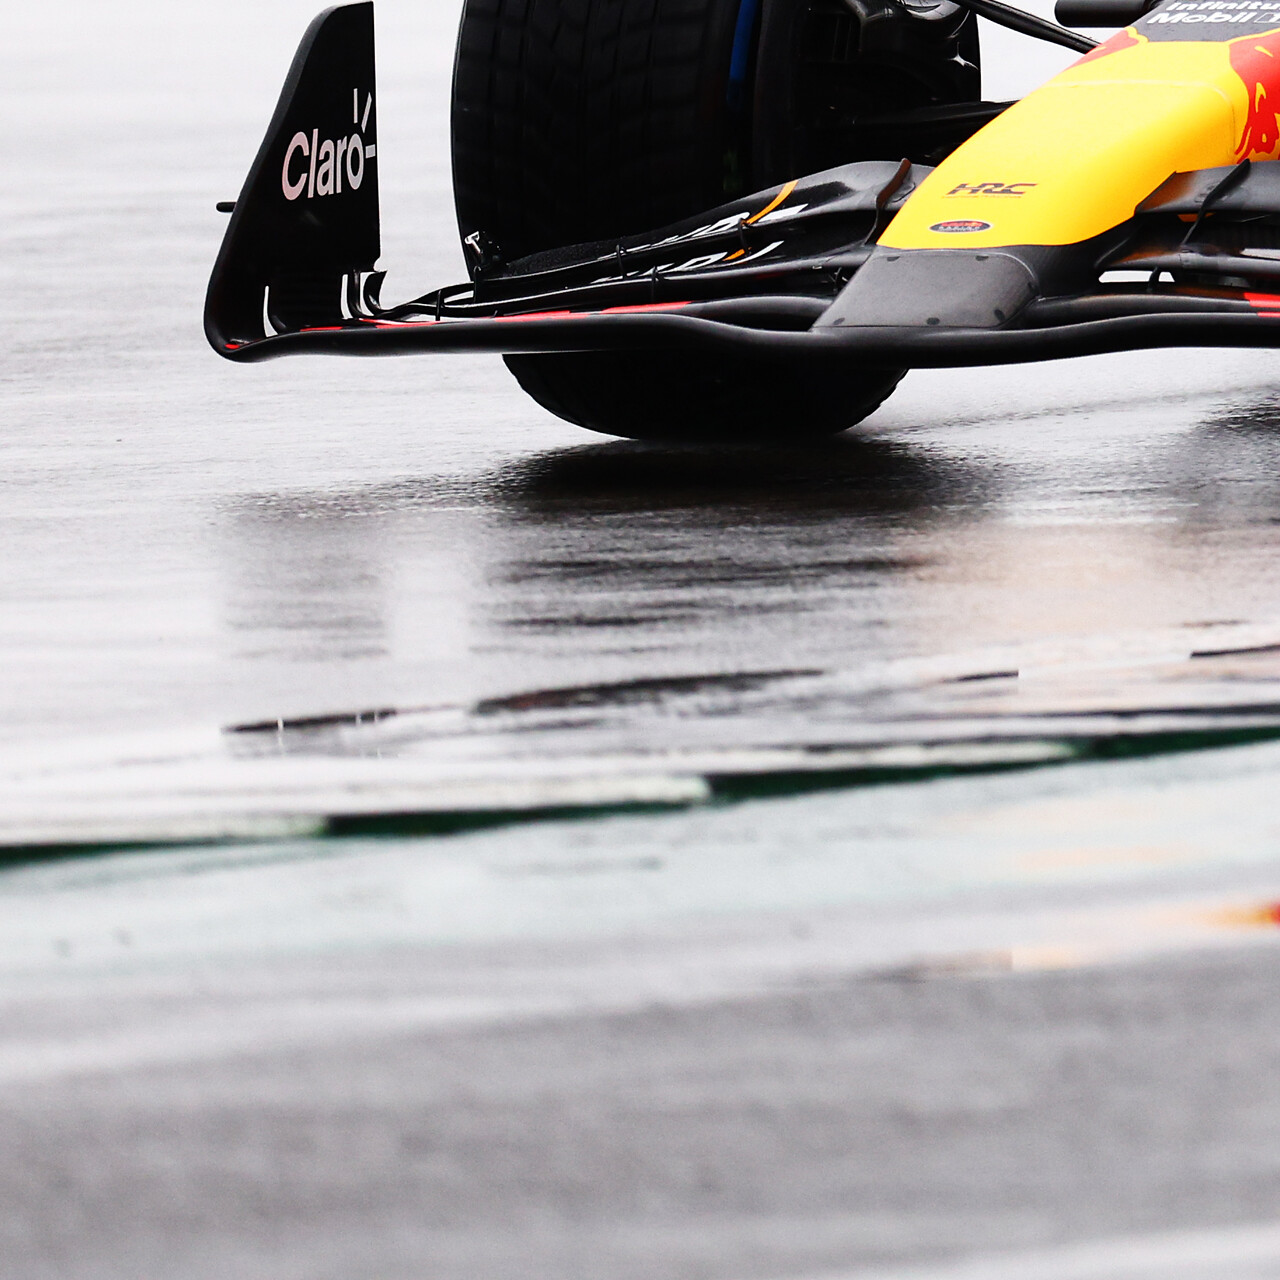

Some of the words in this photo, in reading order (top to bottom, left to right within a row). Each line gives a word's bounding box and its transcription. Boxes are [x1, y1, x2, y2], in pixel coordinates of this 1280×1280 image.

[1146, 11, 1257, 24] Mobil
[281, 127, 365, 201] Claro
[945, 182, 1039, 195] HRC
